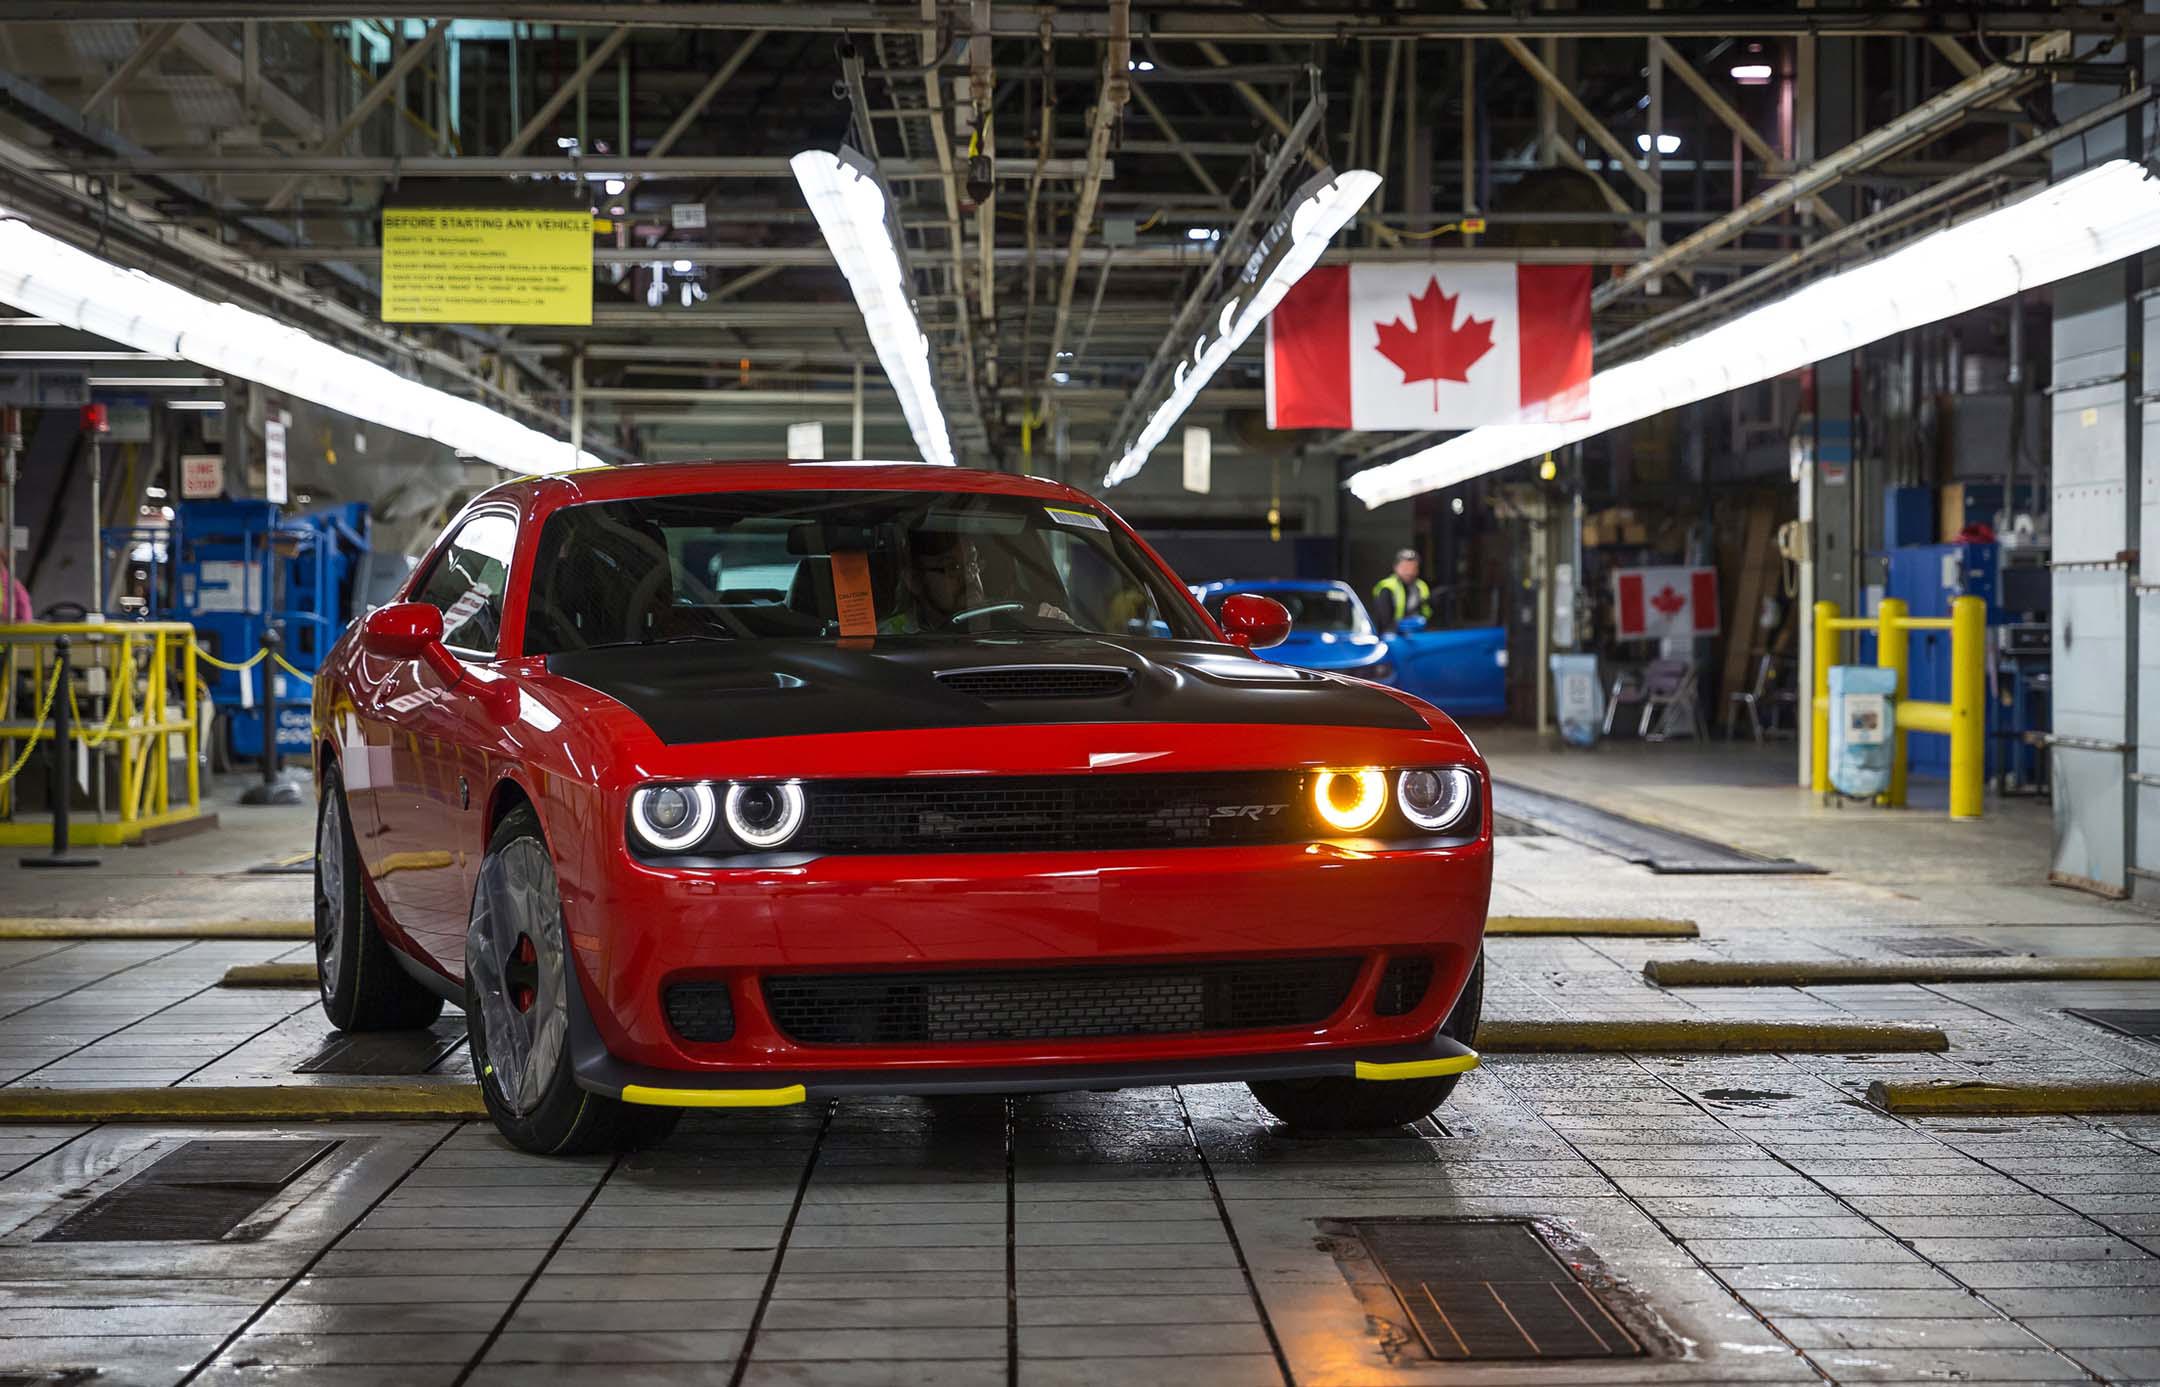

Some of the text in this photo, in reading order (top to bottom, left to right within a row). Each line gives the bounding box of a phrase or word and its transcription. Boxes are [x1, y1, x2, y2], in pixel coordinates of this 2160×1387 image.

[384, 216, 590, 232] BEFORE STARTING ANY VEHICLE
[1210, 804, 1290, 821] SRT
